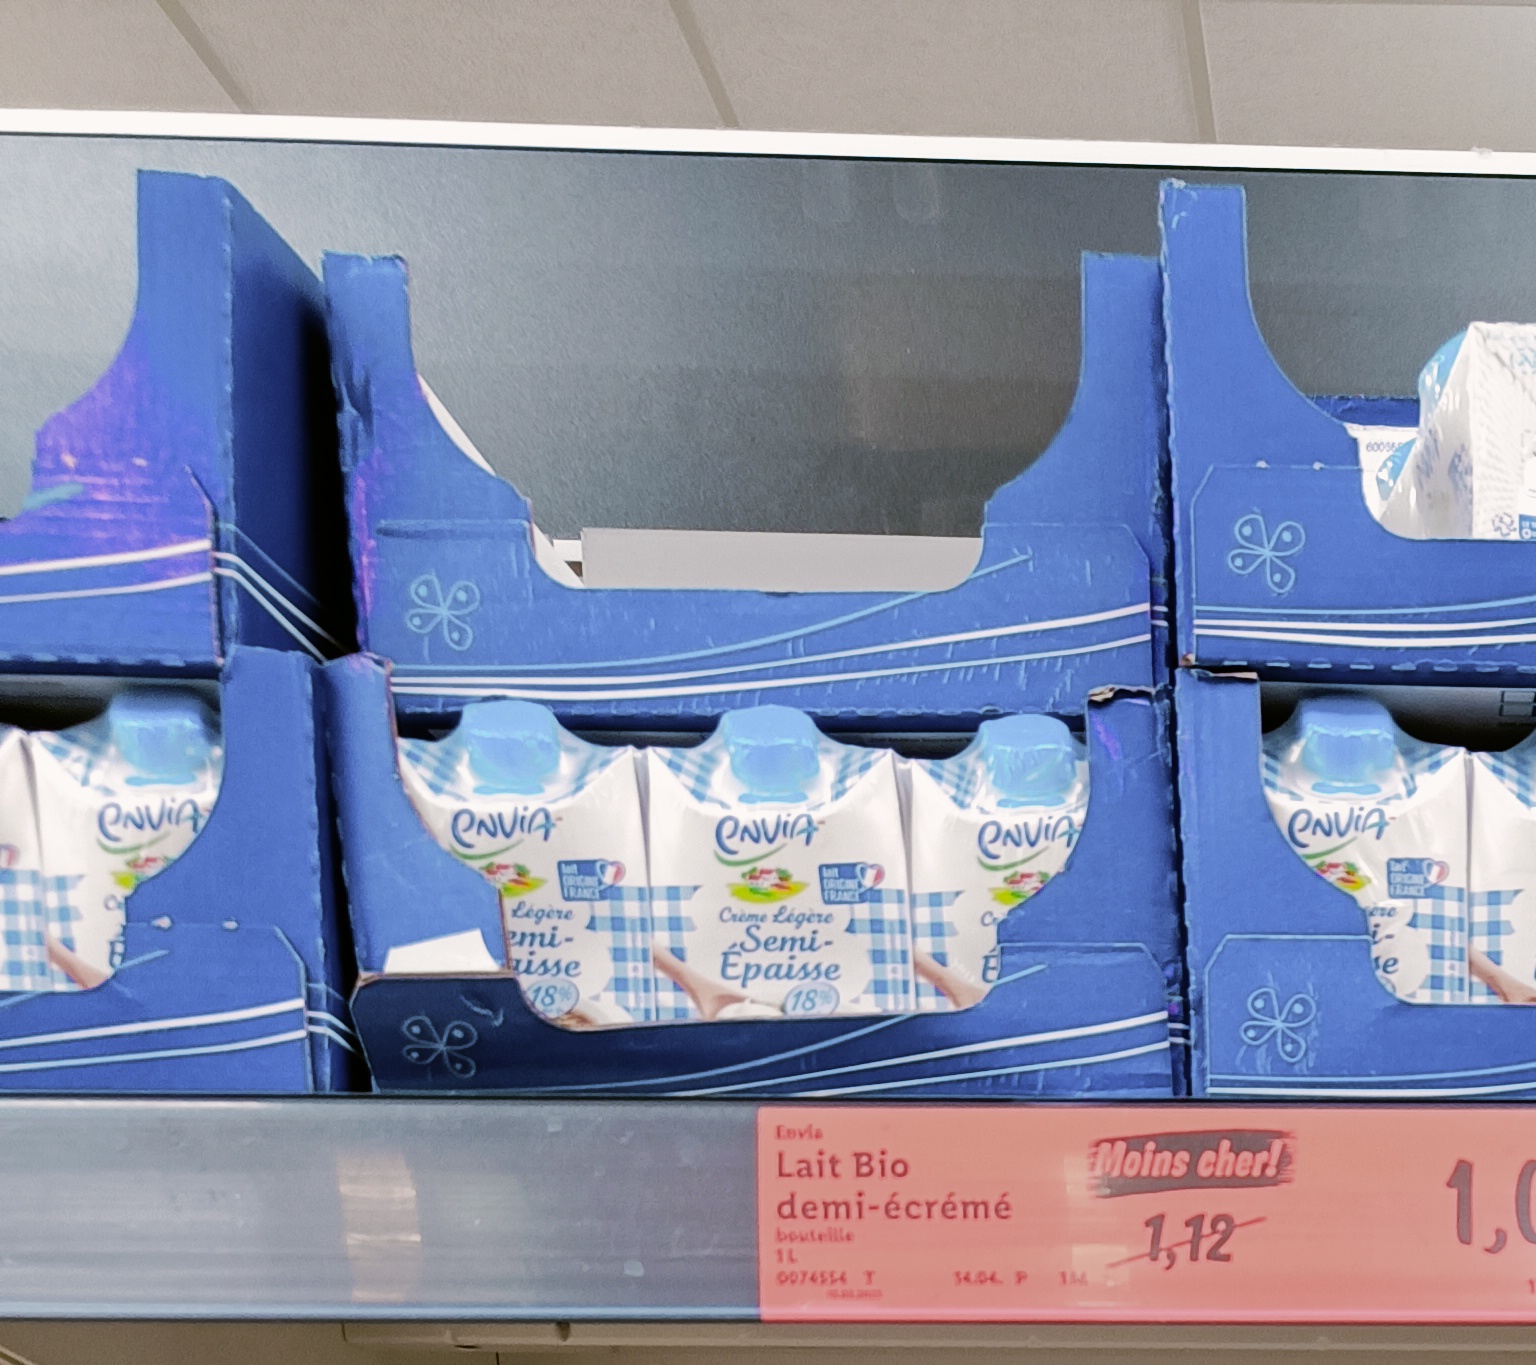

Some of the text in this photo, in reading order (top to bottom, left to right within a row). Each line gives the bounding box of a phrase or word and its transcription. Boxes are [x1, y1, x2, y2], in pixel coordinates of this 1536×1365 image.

[718, 906, 834, 929] Crème Légère
[507, 930, 574, 950] emi-
[738, 924, 834, 953] Semi-
[511, 957, 582, 978] aisse
[720, 943, 842, 989] Épaisse
[775, 1124, 823, 1140] Envia
[776, 1150, 910, 1179] Lait Bio
[1101, 1137, 1284, 1178] Moins cher!
[775, 1190, 1013, 1221] demi-écrémé
[775, 1227, 855, 1243] bouteille
[1144, 1212, 1235, 1271] 1,12
